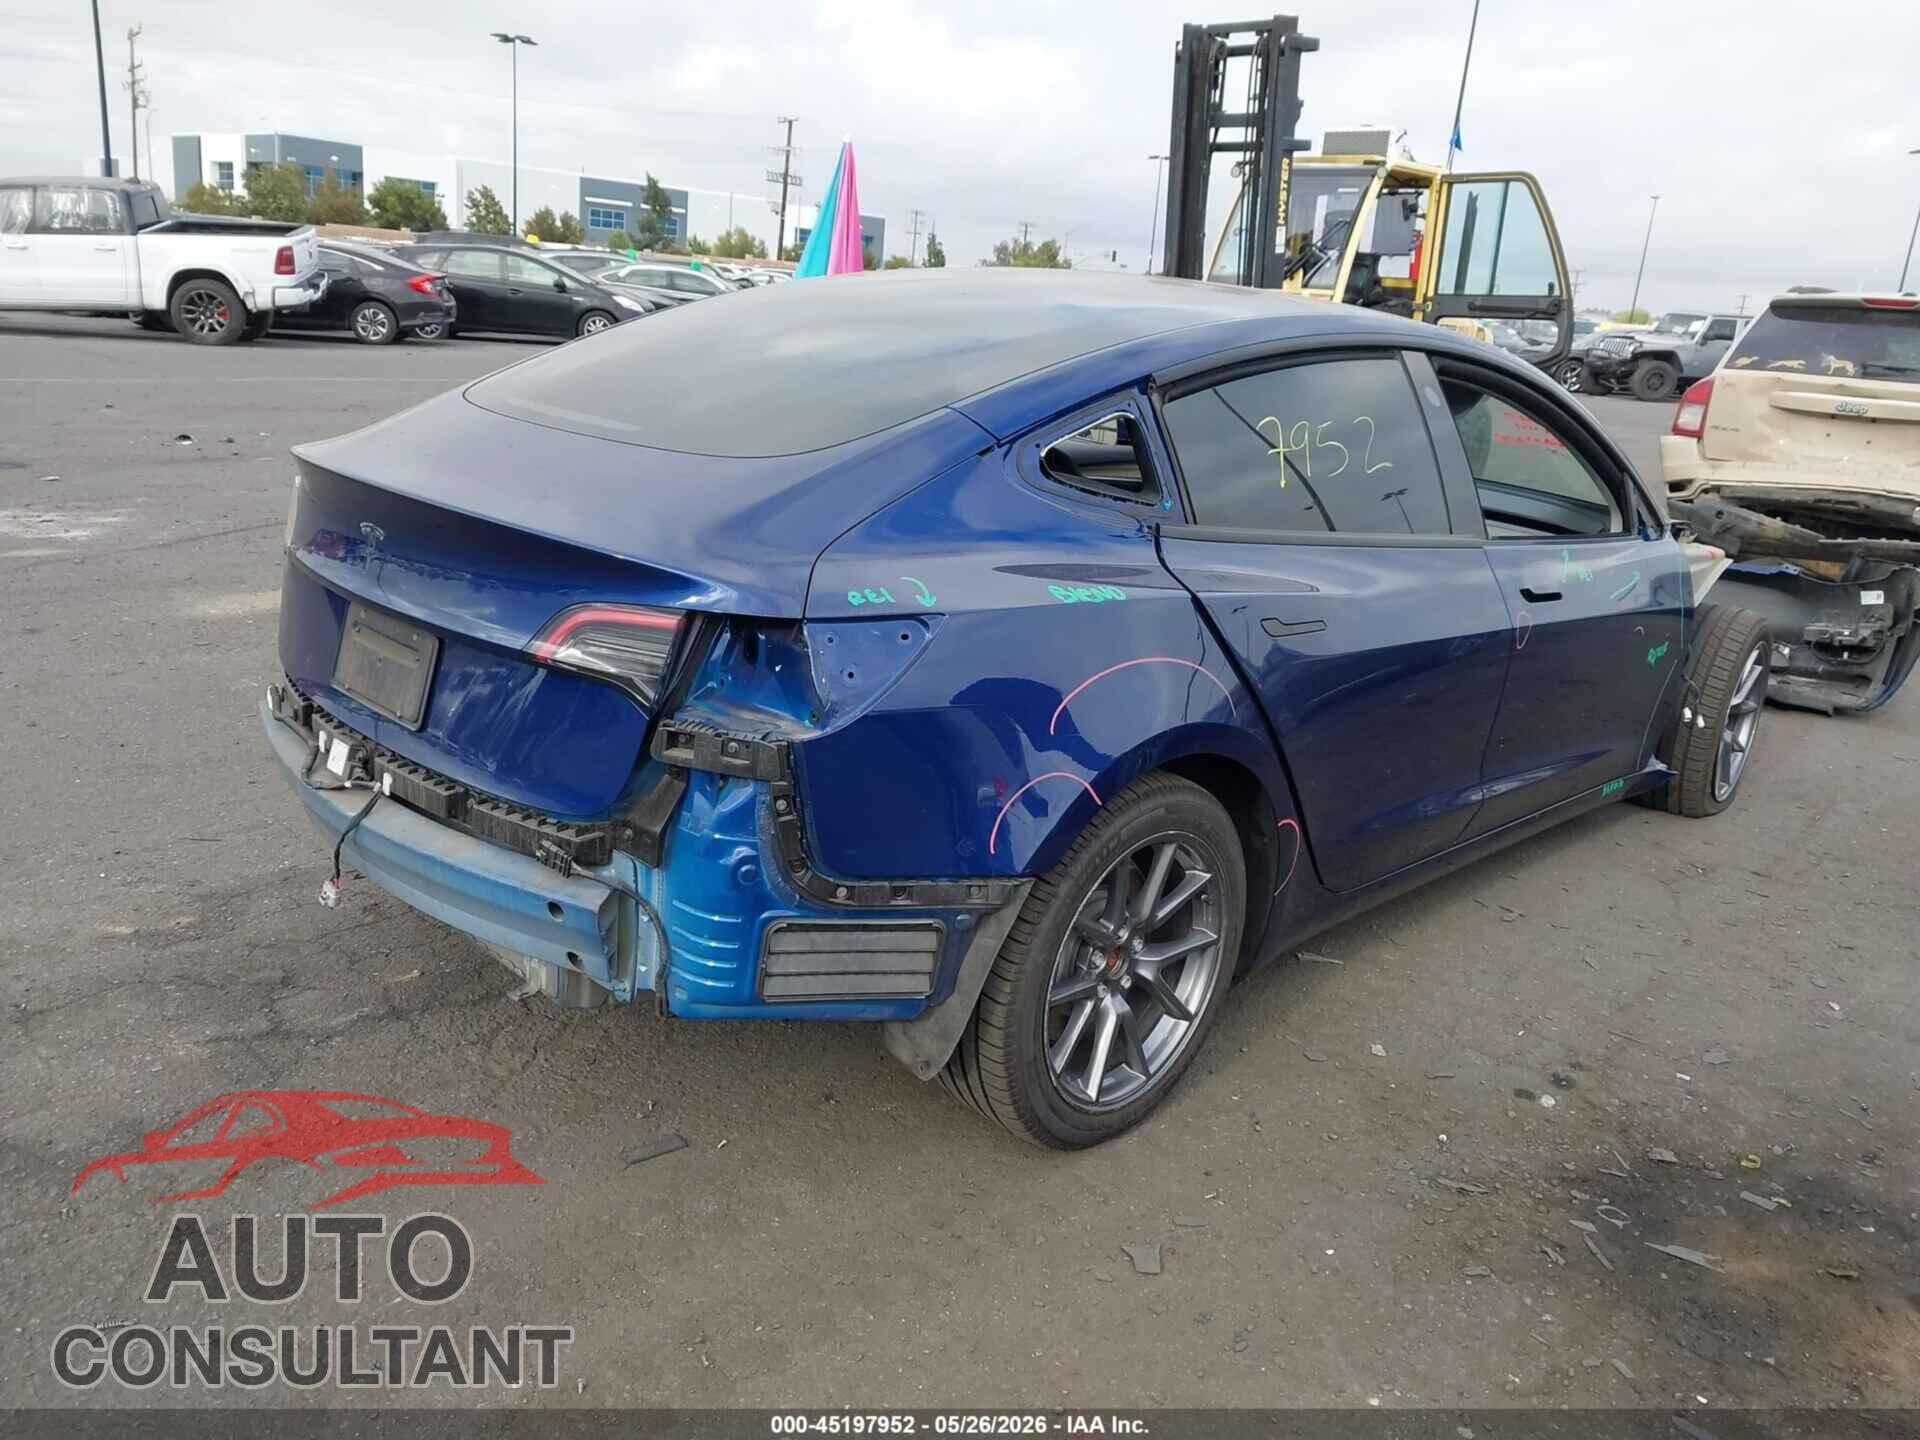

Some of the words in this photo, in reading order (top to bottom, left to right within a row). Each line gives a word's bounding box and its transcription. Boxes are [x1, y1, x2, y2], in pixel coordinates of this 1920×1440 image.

[1277, 157, 1290, 225] HYSTER
[1834, 399, 1868, 417] Jeep
[1256, 415, 1393, 489] 7952
